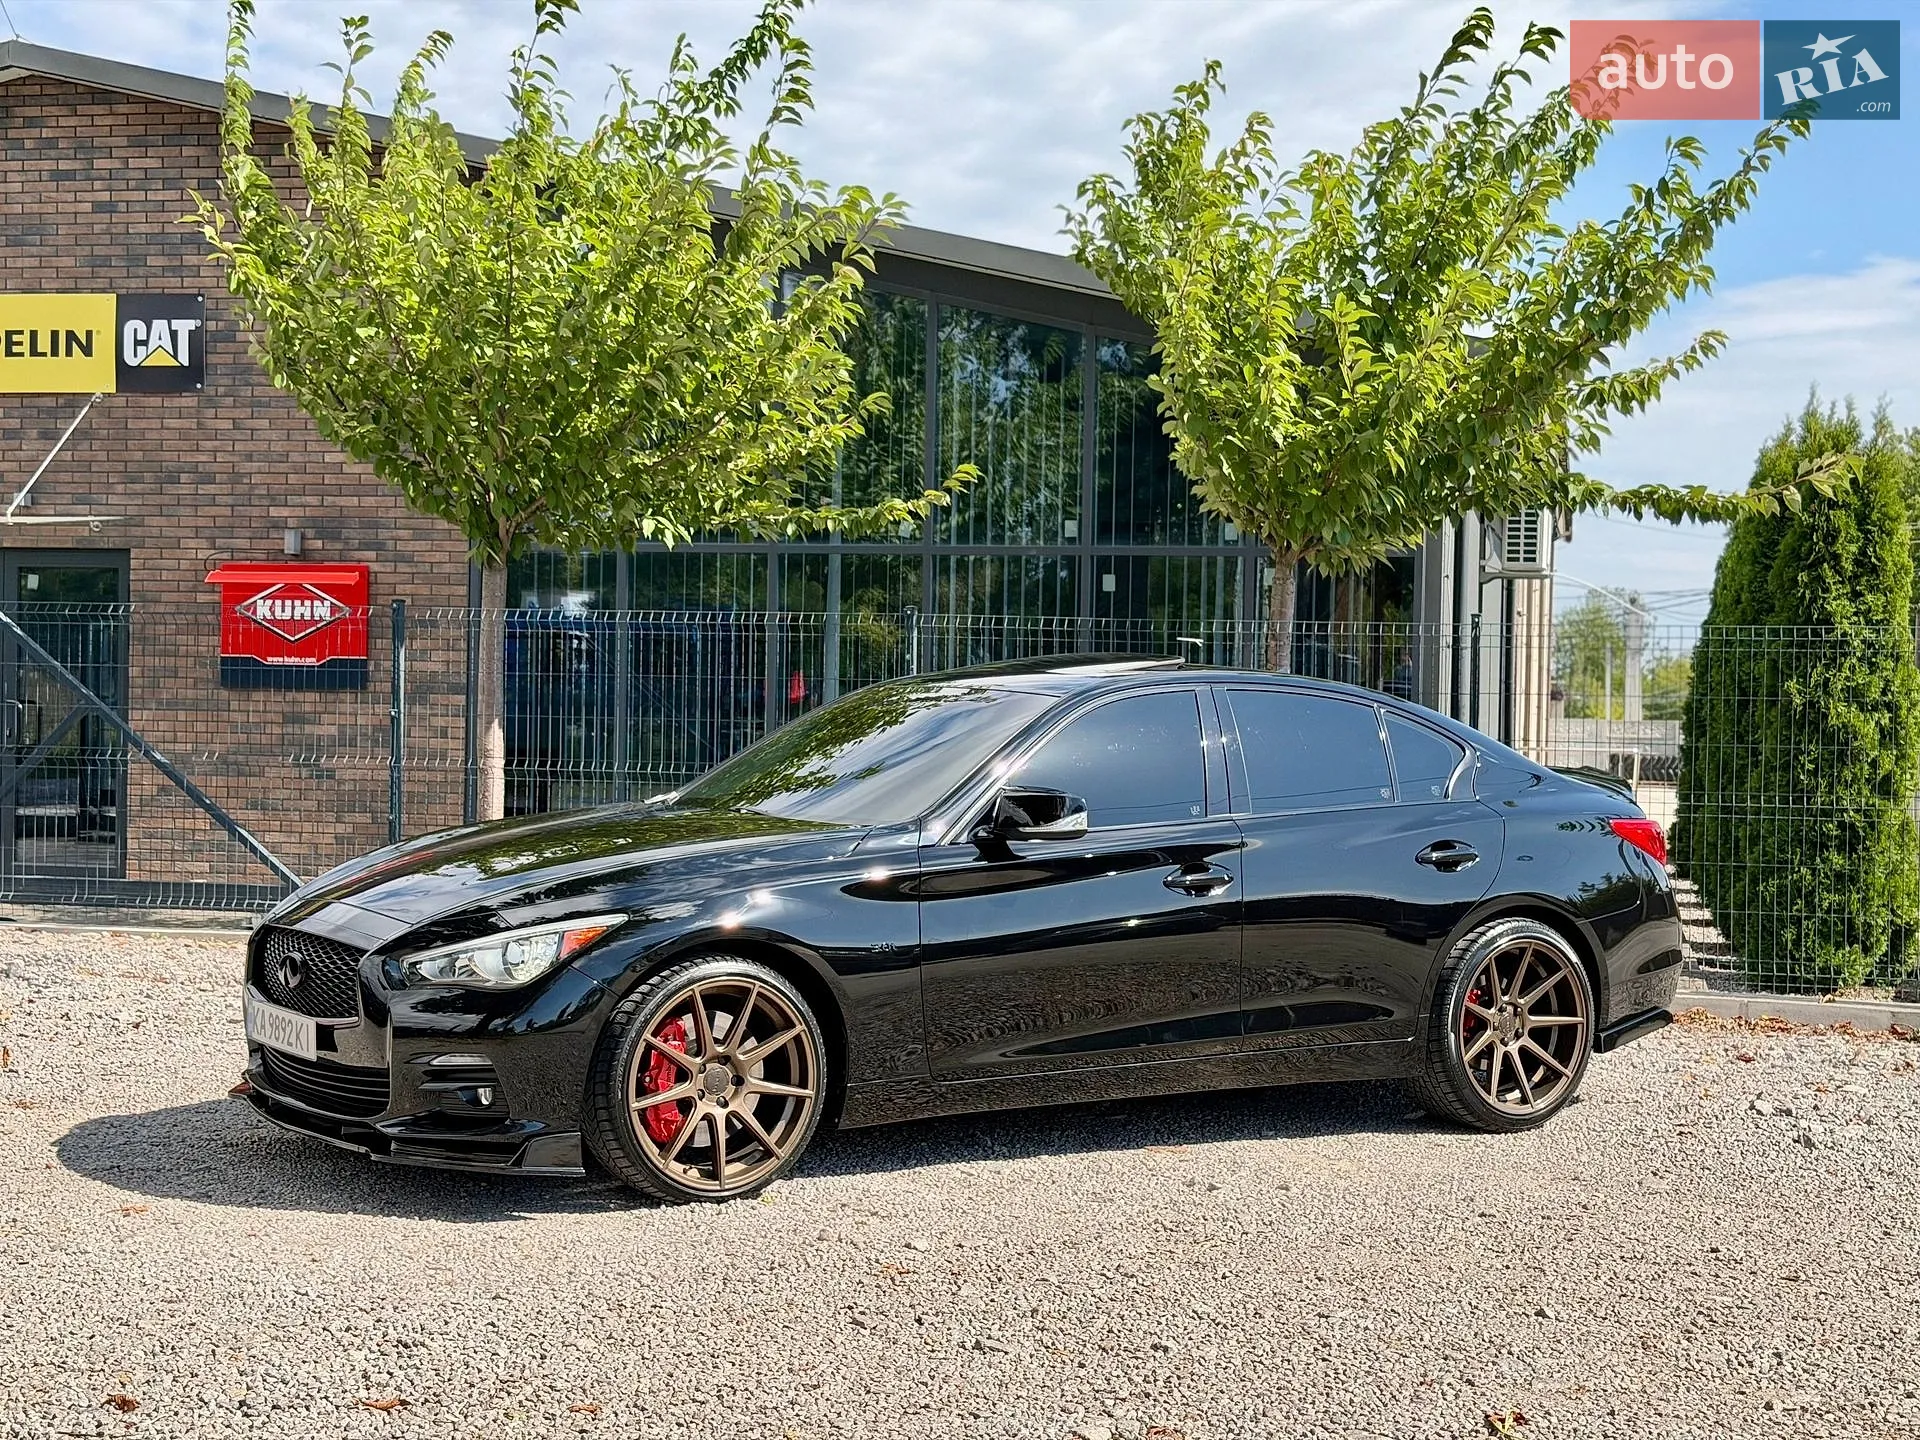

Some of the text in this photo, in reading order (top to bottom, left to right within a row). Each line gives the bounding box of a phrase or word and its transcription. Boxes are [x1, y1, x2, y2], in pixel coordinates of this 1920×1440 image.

[0, 329, 94, 358] ELIN
[123, 319, 196, 367] CAT
[256, 599, 331, 620] KUHN
